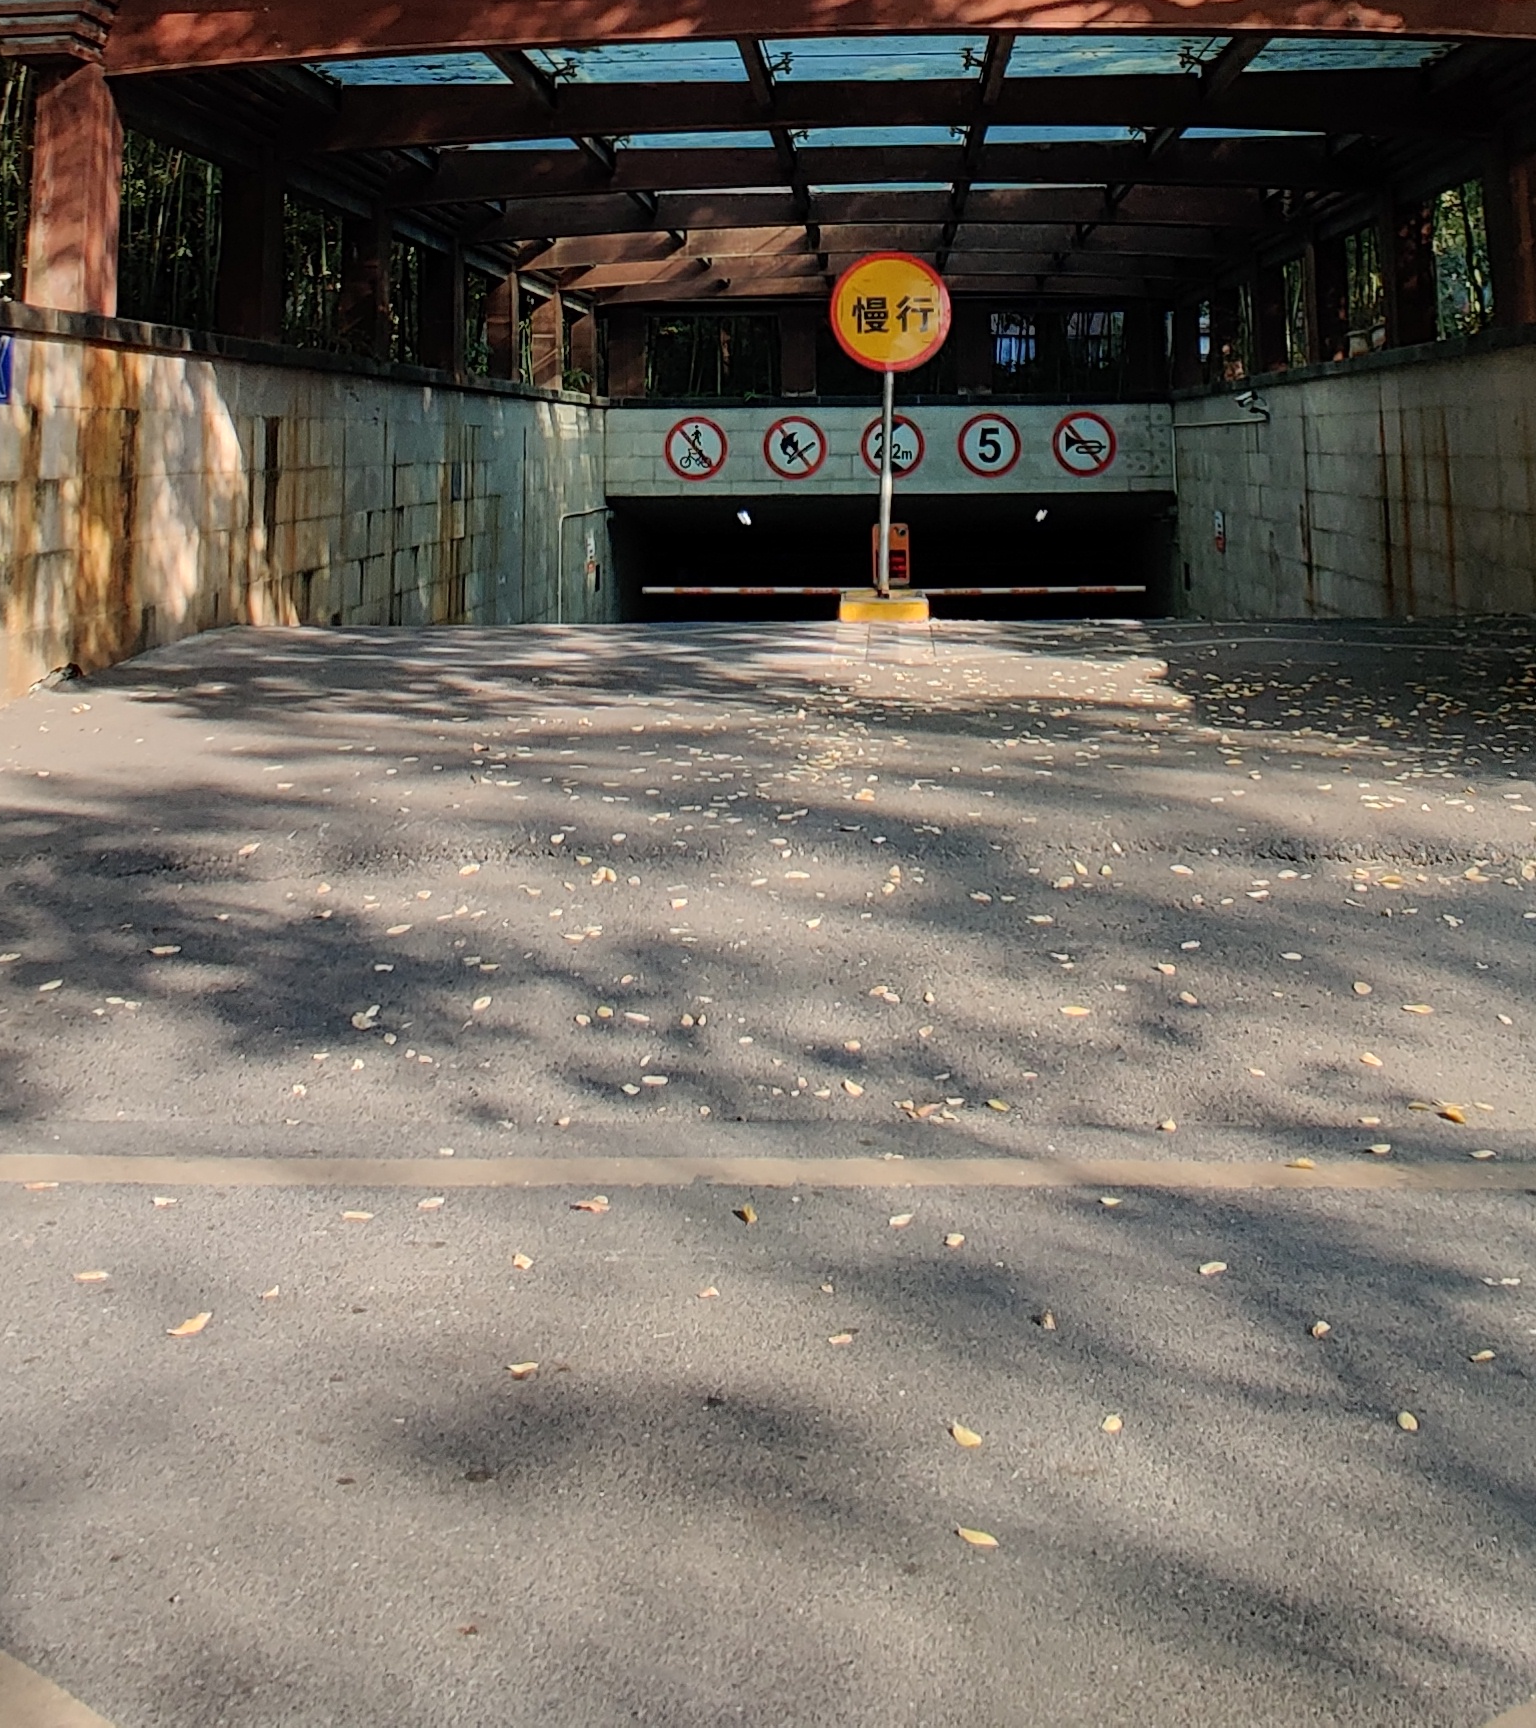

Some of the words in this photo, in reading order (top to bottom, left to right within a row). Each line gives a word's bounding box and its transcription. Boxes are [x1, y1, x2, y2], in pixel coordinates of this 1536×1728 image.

[851, 295, 934, 334] 慢行
[874, 432, 913, 461] 22m
[978, 427, 1002, 463] 5
